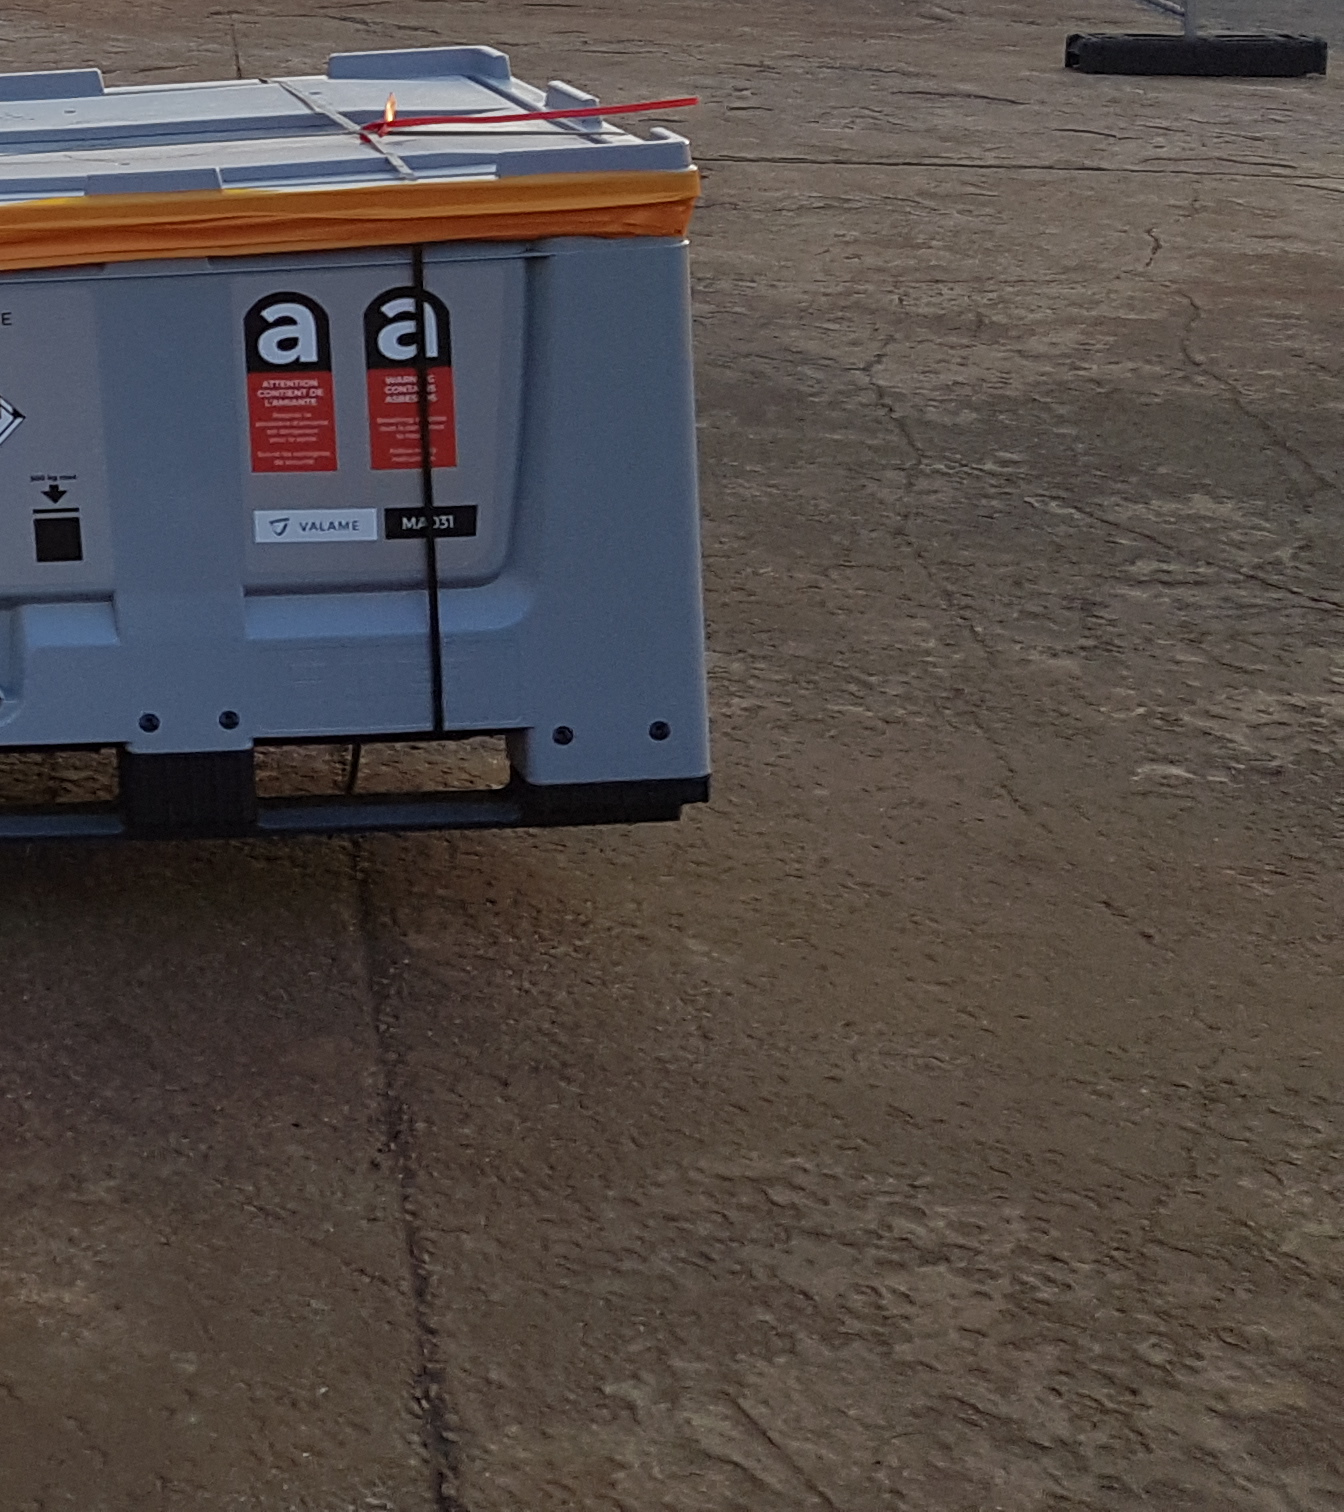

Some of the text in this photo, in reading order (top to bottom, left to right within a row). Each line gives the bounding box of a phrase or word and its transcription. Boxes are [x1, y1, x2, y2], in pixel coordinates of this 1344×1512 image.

[257, 302, 319, 365] a
[262, 378, 318, 388] ATTENTION
[385, 375, 435, 384] WARNG
[309, 388, 324, 397] DE
[384, 384, 436, 394] CONTAS
[298, 520, 360, 532] VALAME
